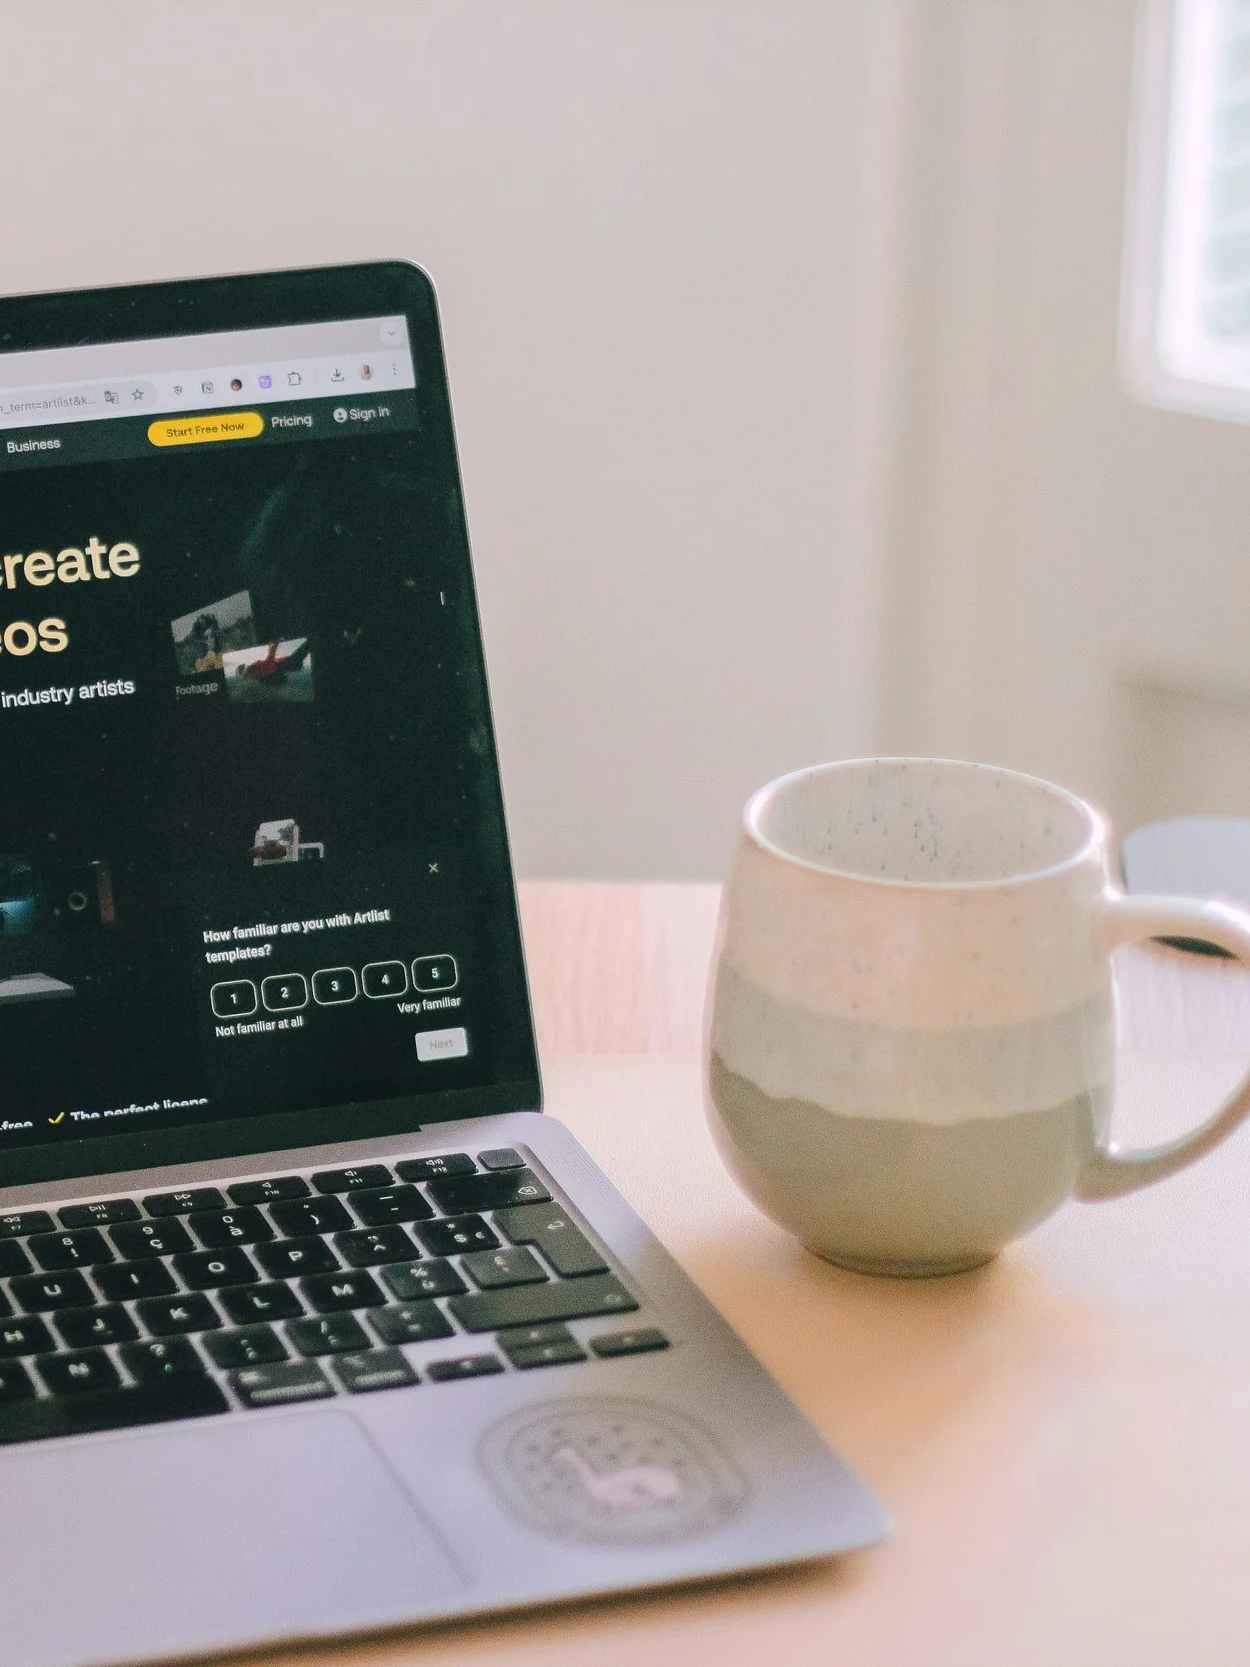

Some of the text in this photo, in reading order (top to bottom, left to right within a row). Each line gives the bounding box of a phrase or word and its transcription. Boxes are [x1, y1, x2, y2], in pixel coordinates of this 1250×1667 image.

[271, 413, 313, 429] Pricing
[349, 405, 390, 422] Sign in
[166, 421, 245, 438] Start Free Now
[6, 438, 61, 454] Business
[1, 685, 74, 708] industry
[78, 678, 136, 700] artists
[175, 681, 219, 697] Footage
[202, 909, 390, 943] How familiar are you with Artlist
[205, 943, 272, 964] templates?
[230, 967, 439, 1005] 1 2 3 4 5
[397, 996, 462, 1015] Very familiar
[215, 1015, 304, 1037] Not familiar at all
[429, 1037, 454, 1050] Next
[142, 1226, 153, 1235] 9
[61, 1237, 73, 1247] 8
[288, 1250, 303, 1262] P
[43, 1284, 62, 1297] U
[331, 1283, 354, 1297] M
[253, 1296, 270, 1309] L
[169, 1306, 188, 1321] K
[92, 1318, 106, 1332] J
[3, 1330, 25, 1342] H
